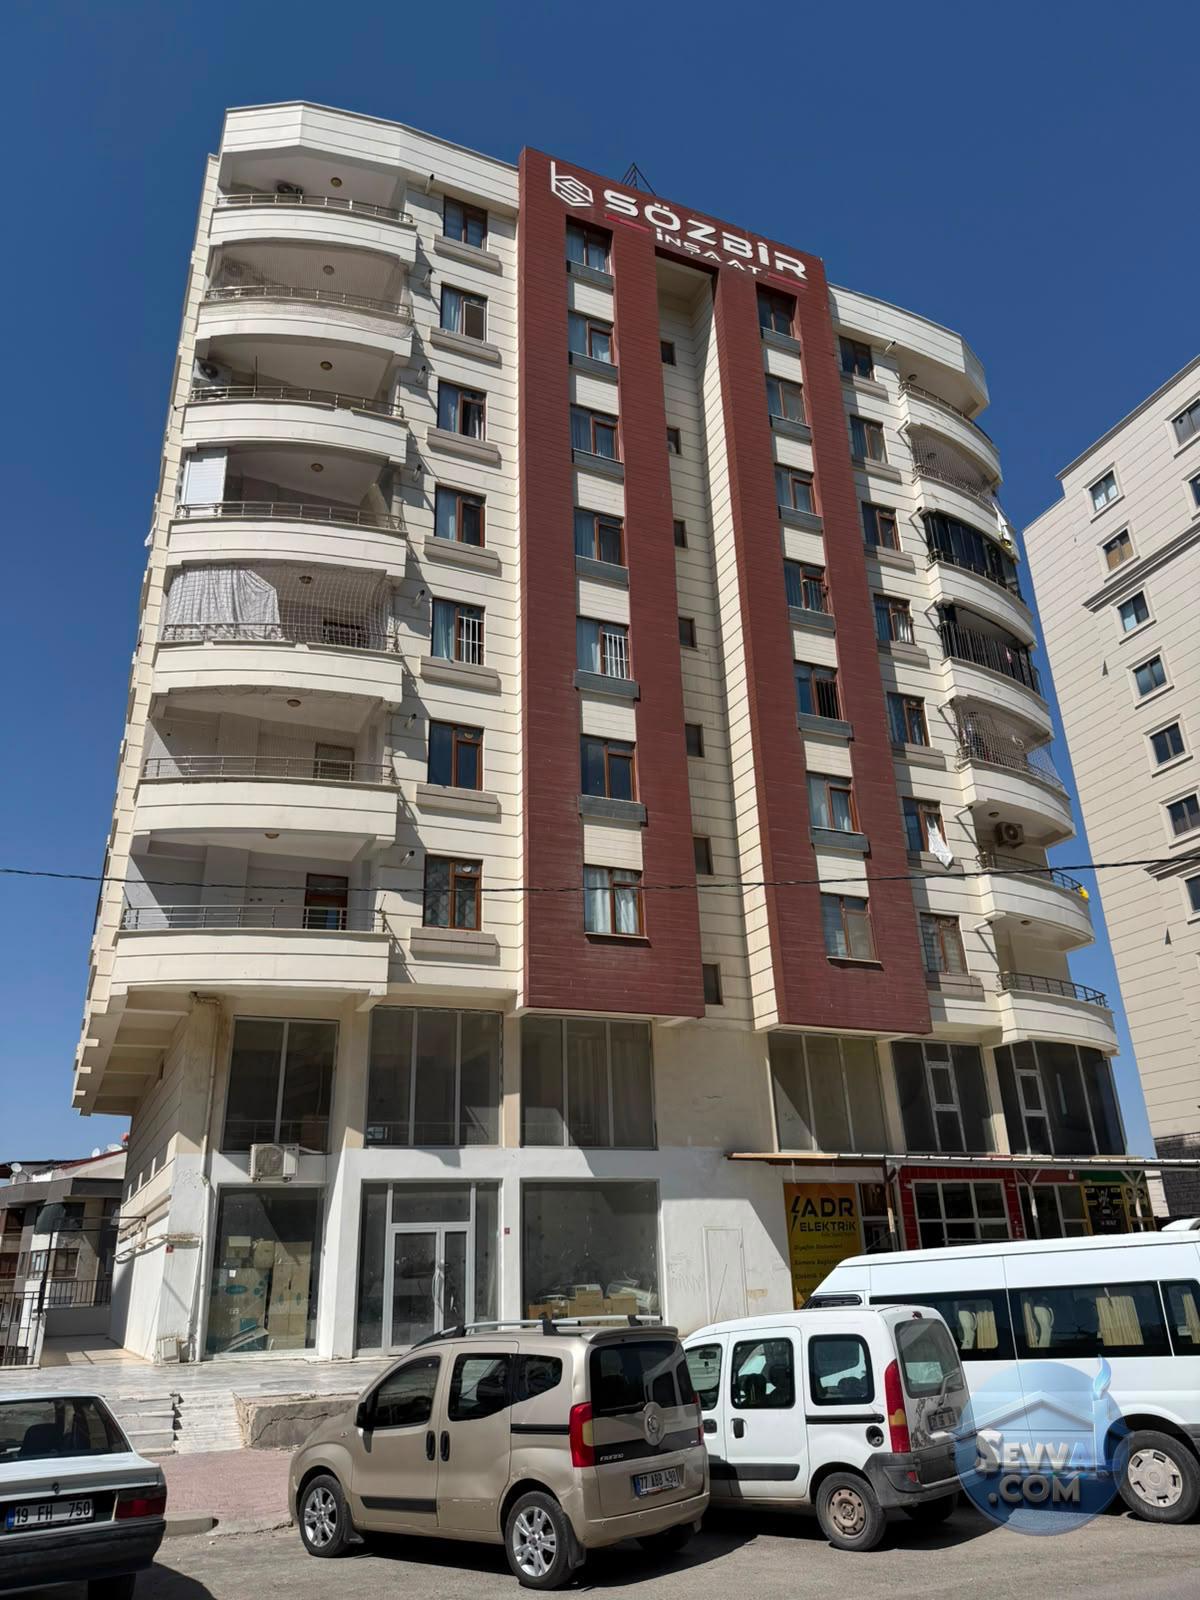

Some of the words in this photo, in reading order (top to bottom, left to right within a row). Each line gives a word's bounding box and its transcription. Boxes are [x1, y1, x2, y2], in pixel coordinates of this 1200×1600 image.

[603, 189, 808, 280] SÖZBİR
[656, 228, 762, 275] İNŞAAT
[801, 1197, 854, 1217] ADR
[15, 1508, 28, 1524] 19
[37, 1505, 53, 1521] FH
[68, 1501, 91, 1517] 750
